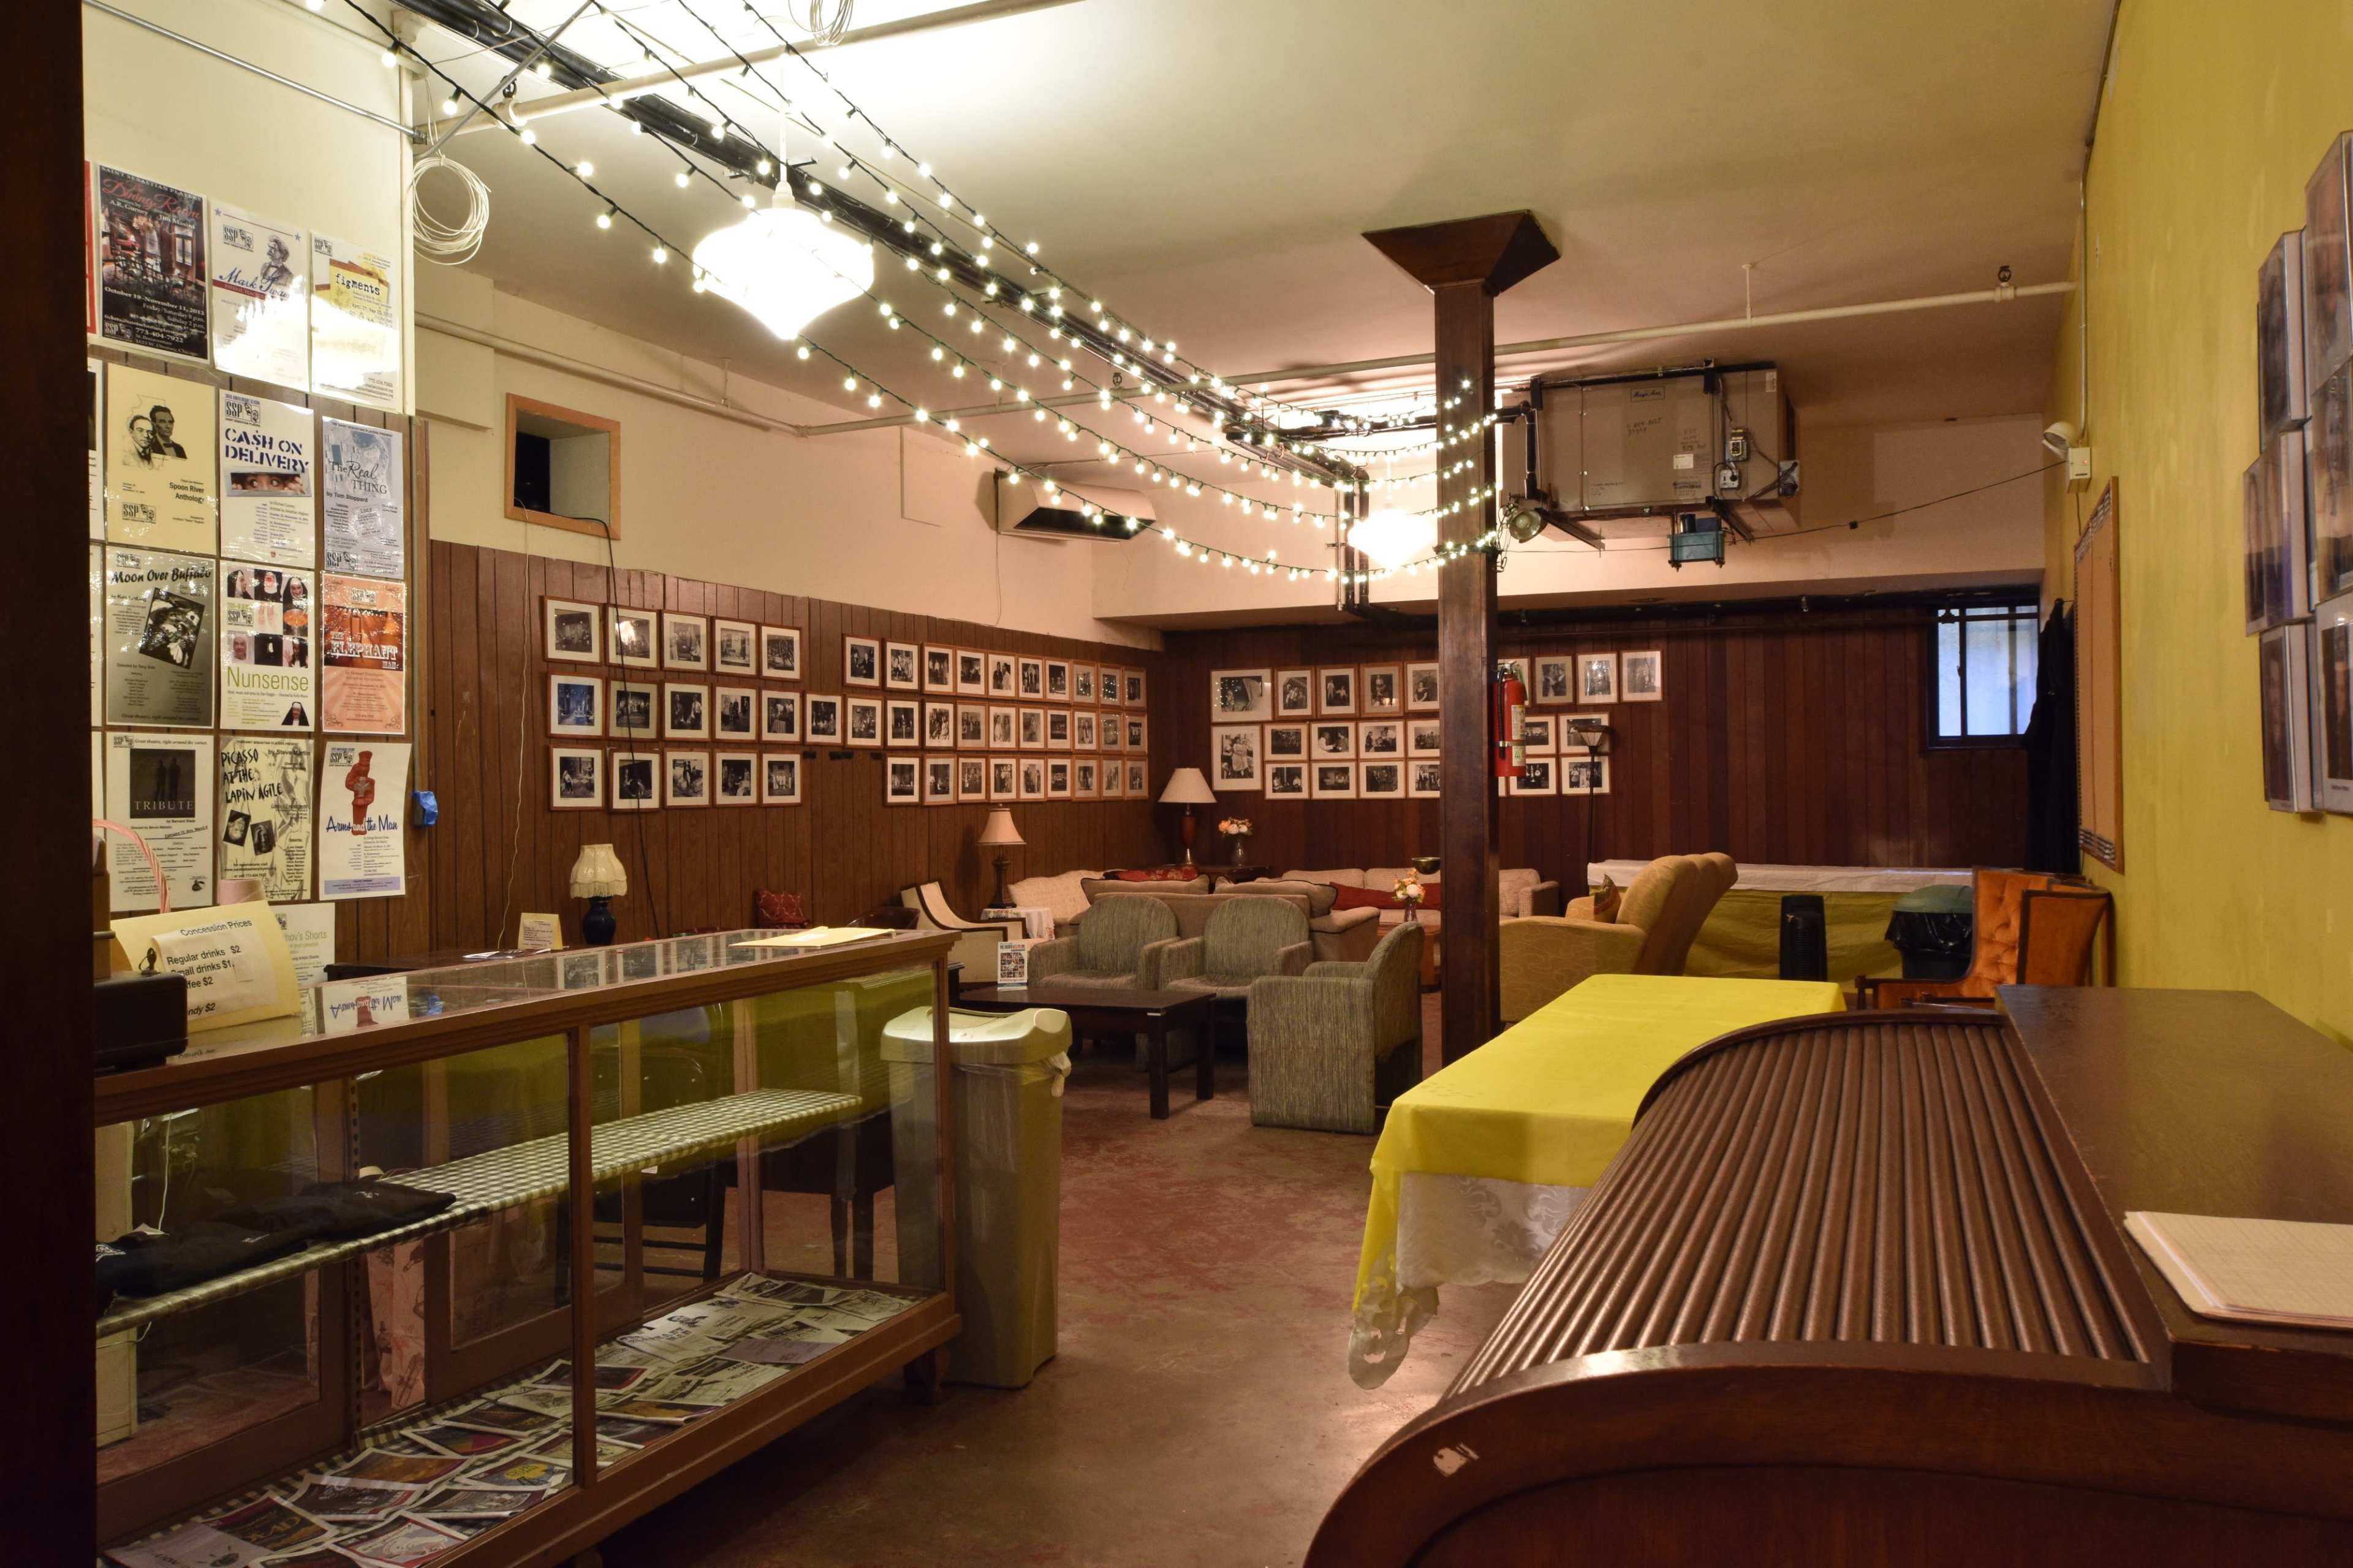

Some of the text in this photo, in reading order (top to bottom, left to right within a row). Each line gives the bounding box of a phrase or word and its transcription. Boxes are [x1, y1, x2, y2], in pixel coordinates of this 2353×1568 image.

[102, 167, 124, 177] SAINT
[127, 175, 169, 191] SEBASTIAN
[102, 179, 157, 210] Dining
[124, 203, 148, 215] Gurney
[224, 227, 238, 243] SSP
[219, 267, 258, 289] Mark
[335, 273, 381, 296] figments
[104, 286, 132, 297] October
[135, 327, 184, 343] 773-404-7922
[226, 401, 242, 417] SSP
[278, 440, 302, 455] ON
[225, 445, 309, 473] DELIVERY
[328, 460, 379, 479] The Real
[170, 482, 188, 491] Spoon
[351, 479, 387, 494] THING
[175, 493, 204, 504] Anthology
[346, 494, 368, 503] Stoppard
[123, 504, 138, 517] SSP
[111, 571, 144, 583] Moon
[147, 569, 168, 581] Over
[228, 610, 240, 622] SSP
[330, 640, 398, 661] ELEPHANT
[227, 666, 308, 691] Nunsense
[330, 752, 342, 763] SSP
[223, 768, 254, 785] AT THE
[134, 800, 194, 811] TRIBUTE
[326, 814, 398, 832] Arms and the Man
[180, 919, 253, 937] Concession Prices
[306, 930, 327, 941] Shorts
[166, 945, 241, 965] Regular drinks $2
[196, 962, 221, 974] drinks
[202, 976, 213, 987] $2
[205, 1002, 216, 1012] $2
